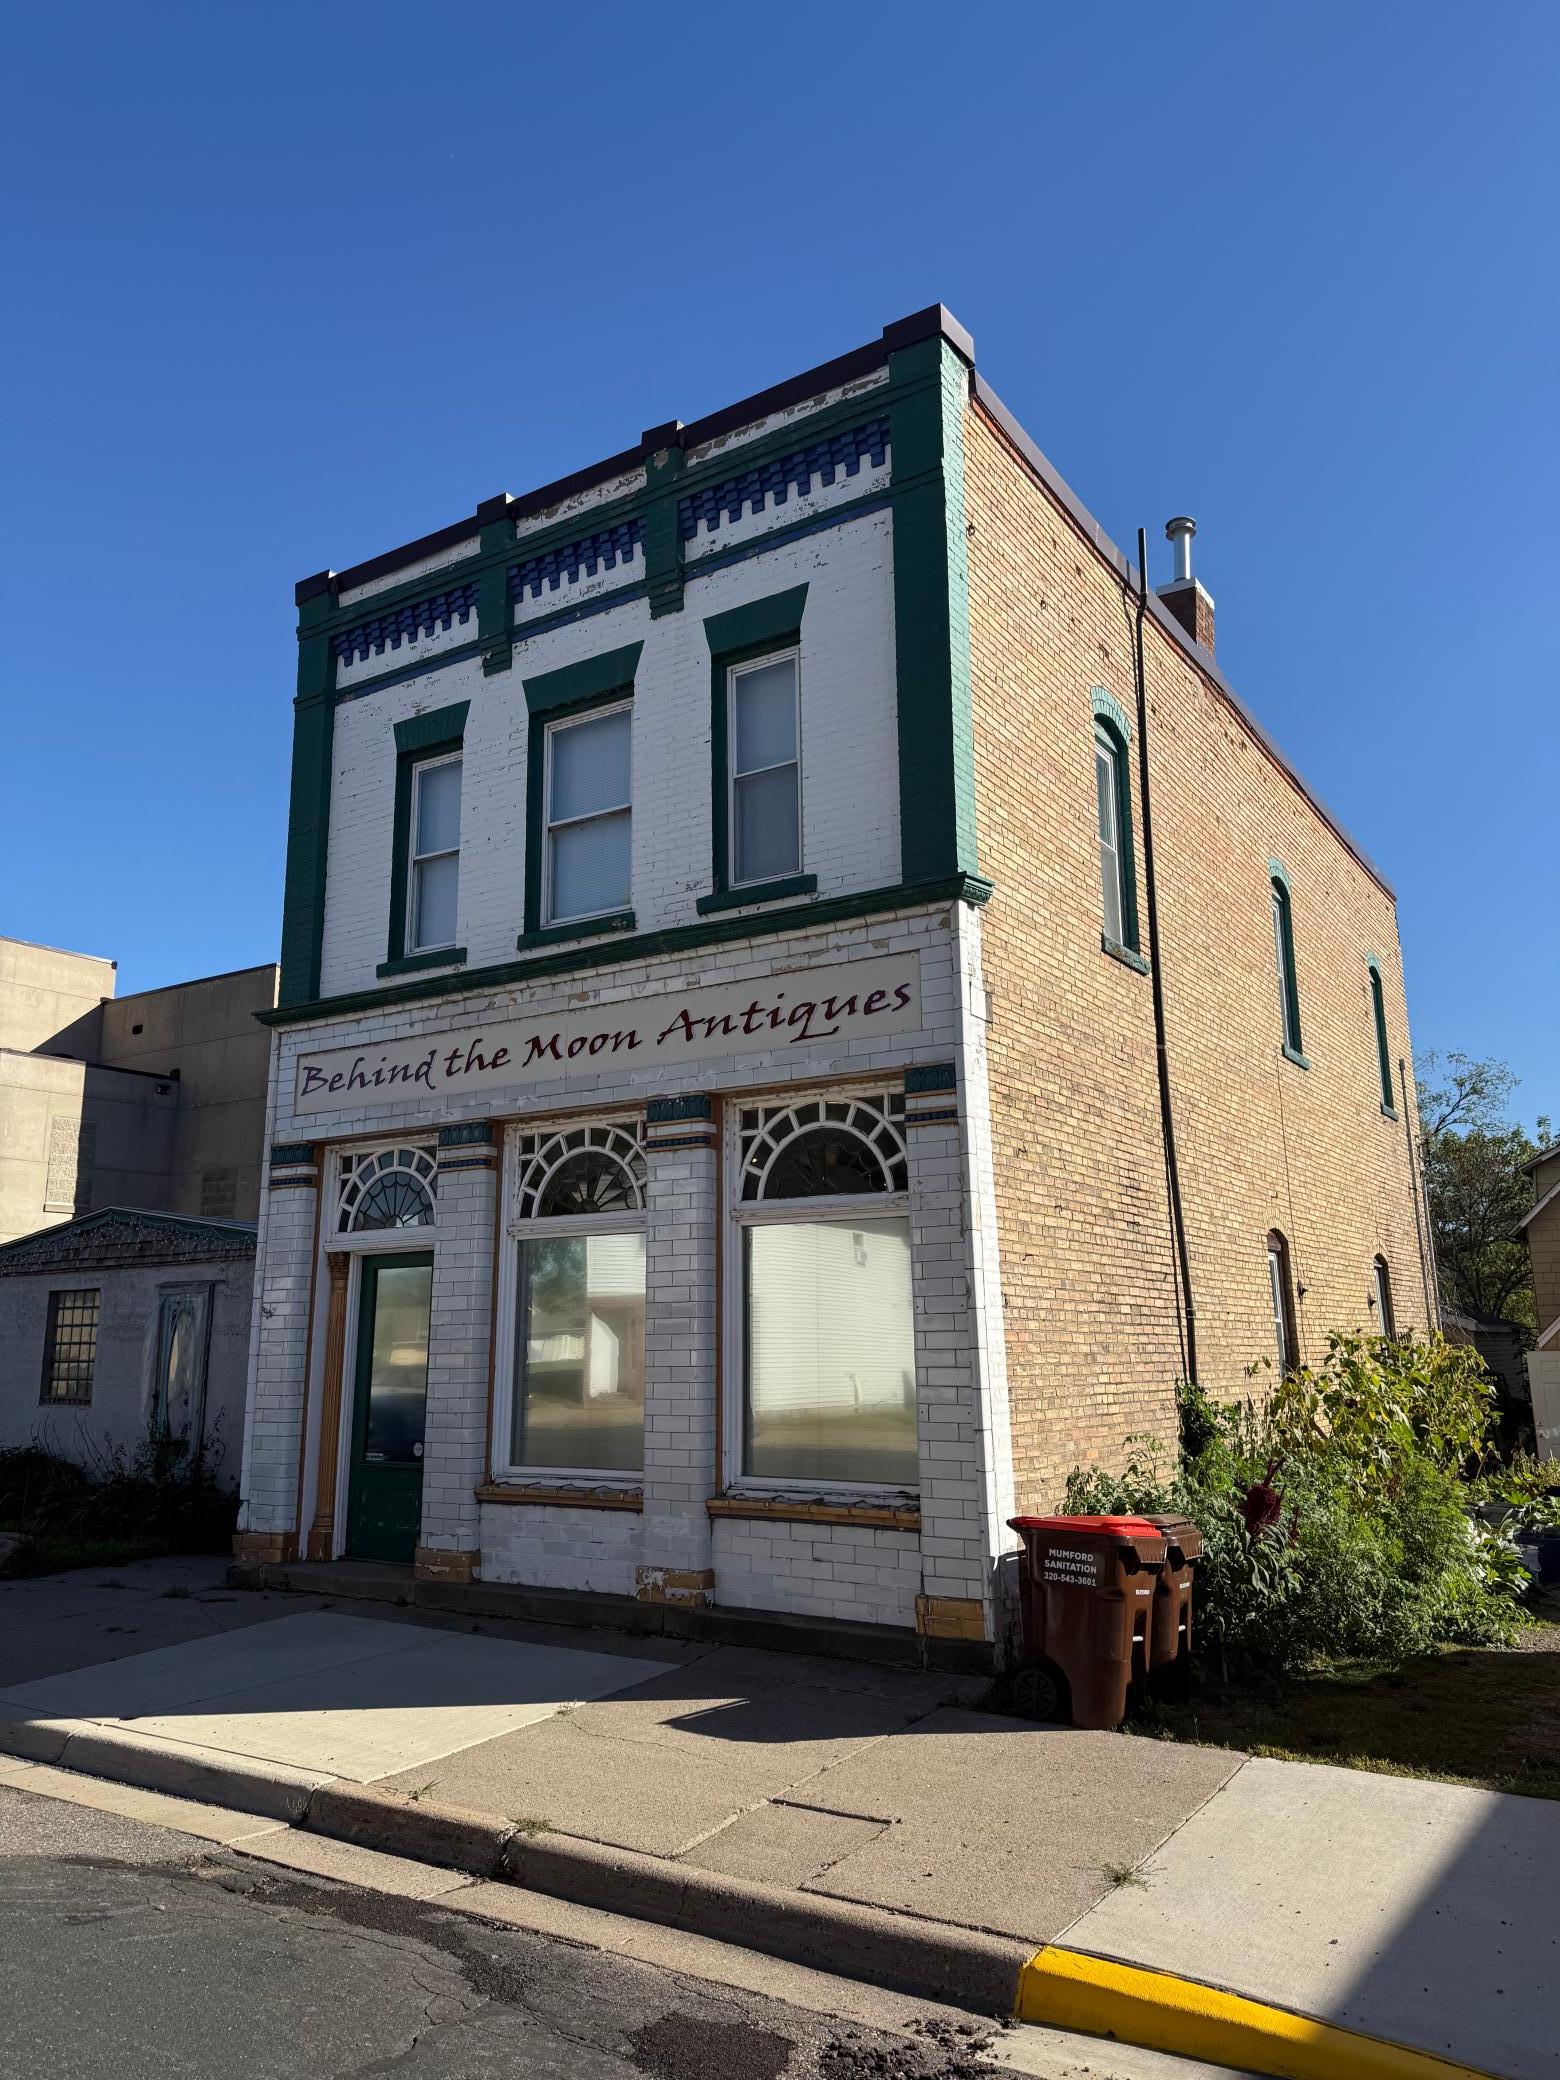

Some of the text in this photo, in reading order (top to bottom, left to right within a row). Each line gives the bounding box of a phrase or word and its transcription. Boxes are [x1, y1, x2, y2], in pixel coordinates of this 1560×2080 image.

[301, 983, 911, 1096] Behind the Moon Antiques
[1048, 1548, 1094, 1562] MUMFORD
[1044, 1559, 1097, 1574] SANITATION
[1043, 1571, 1097, 1587] 320-543-3601
